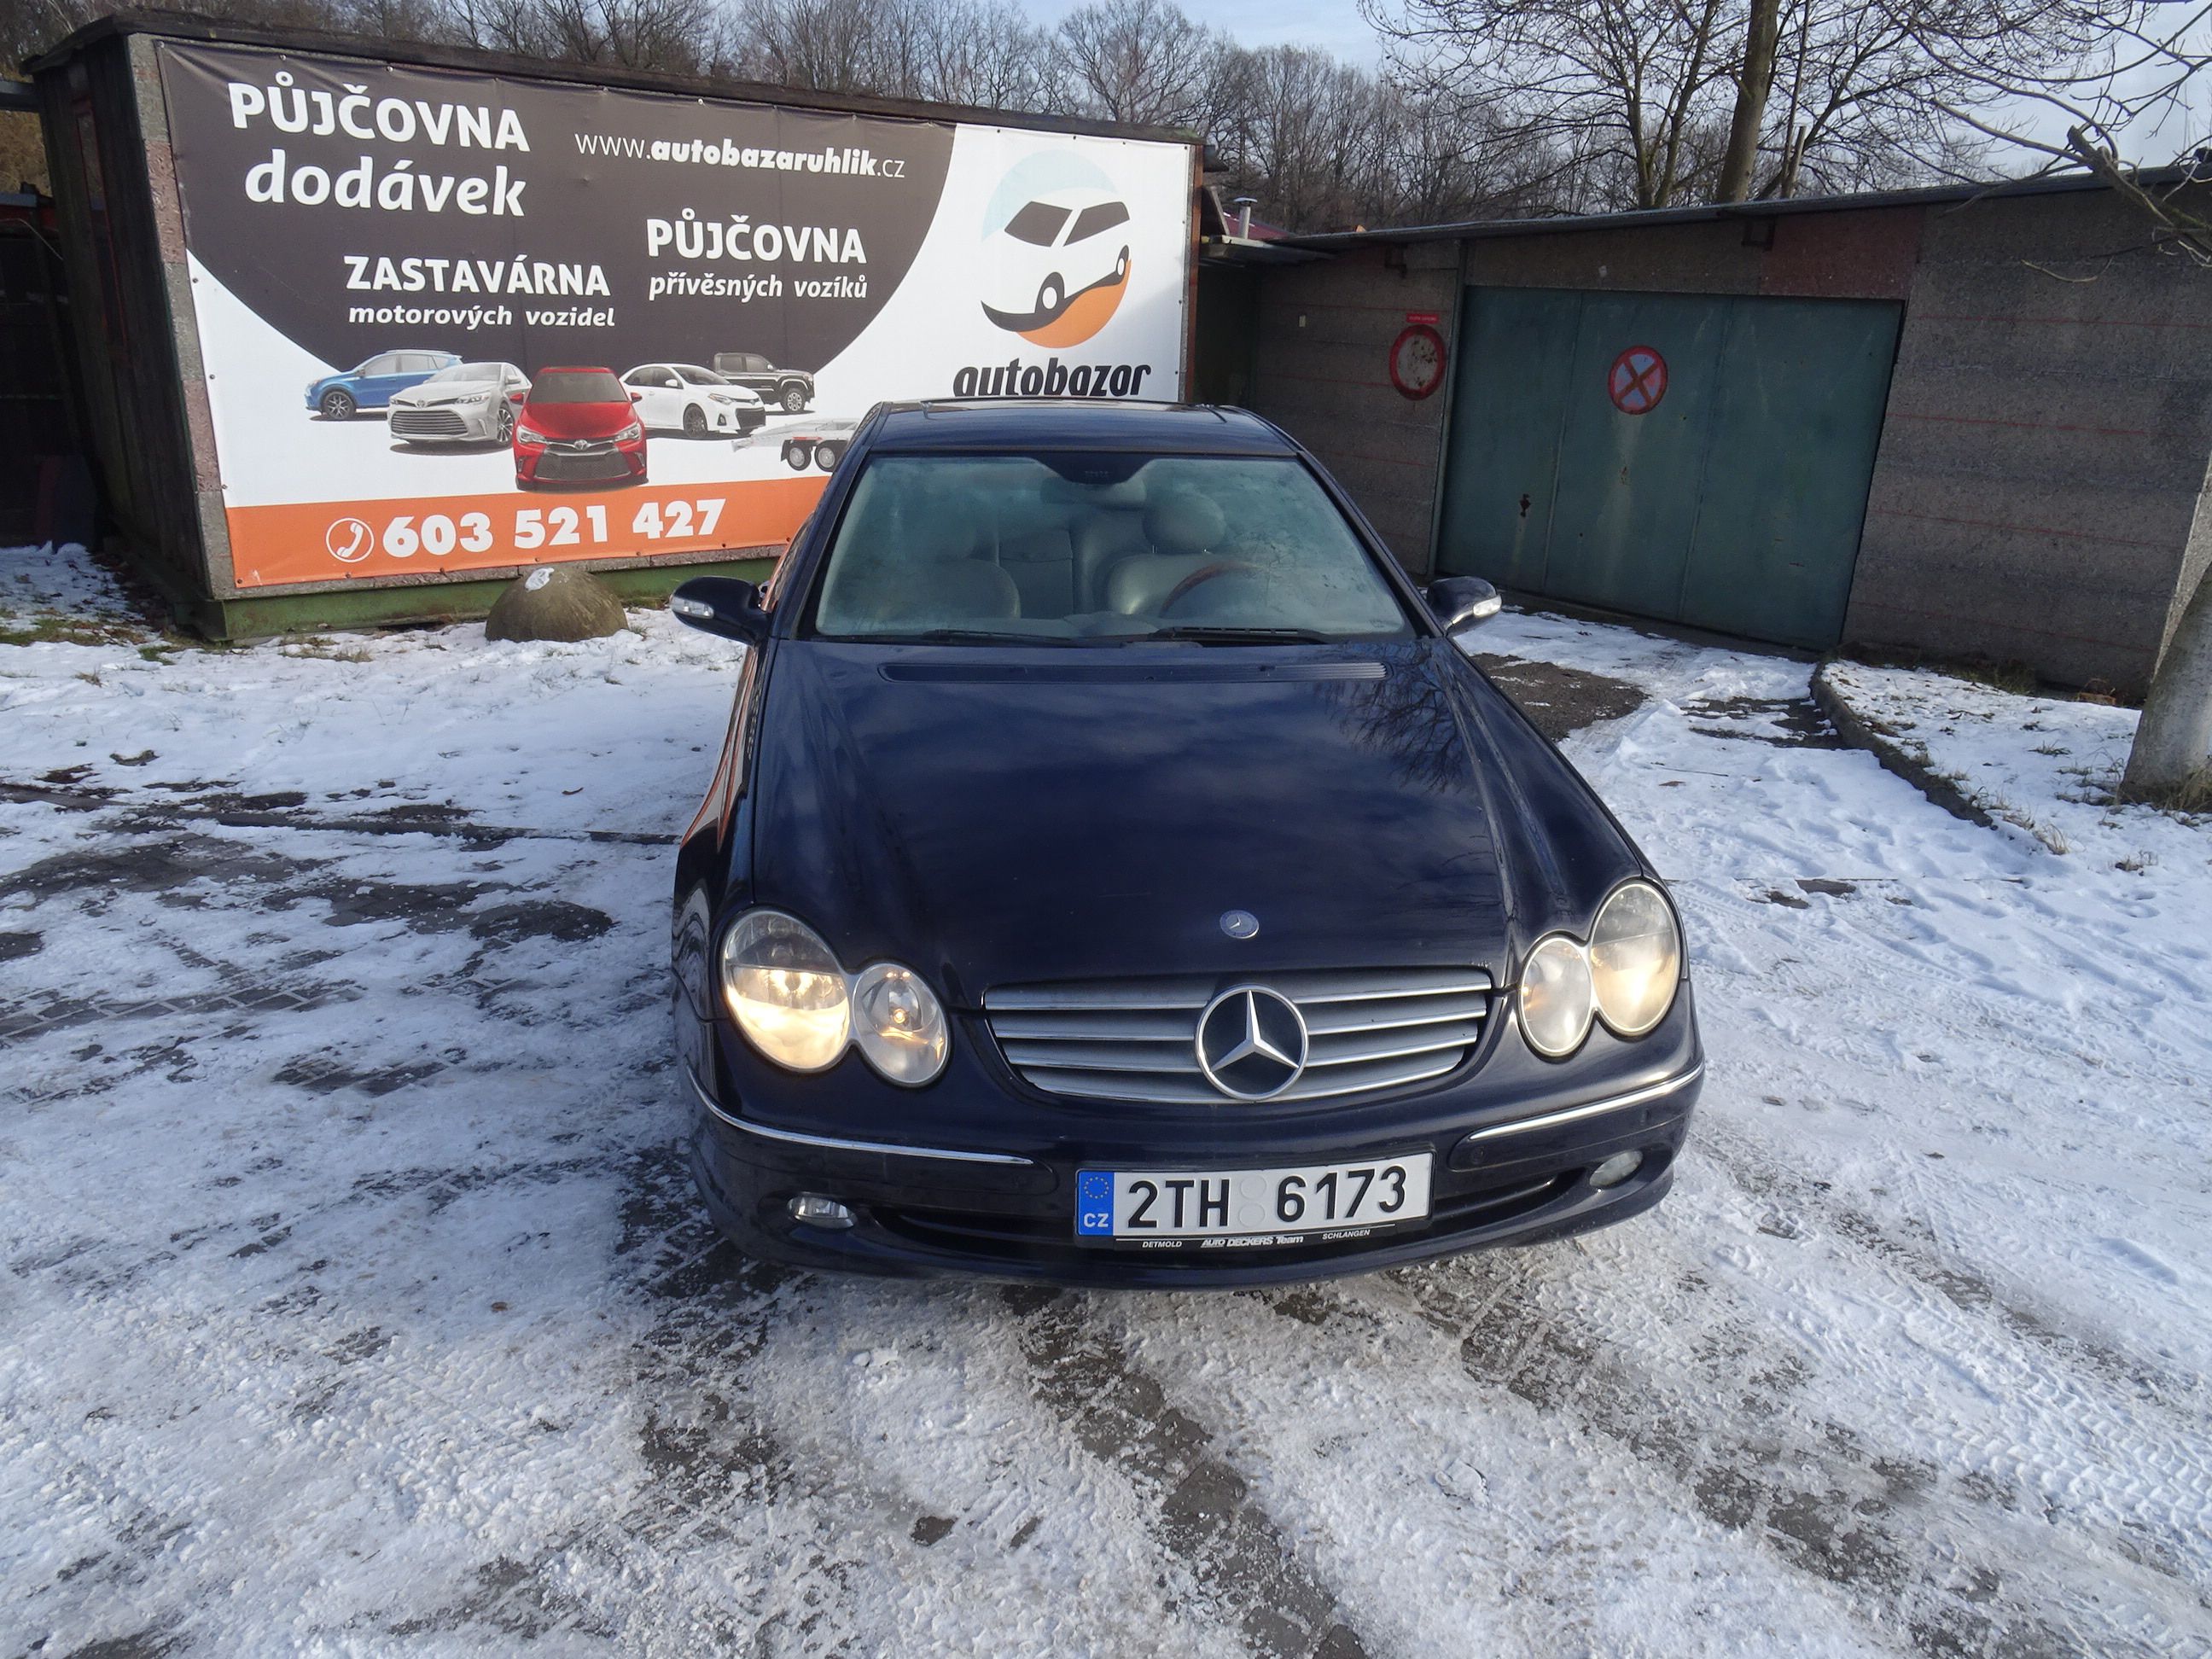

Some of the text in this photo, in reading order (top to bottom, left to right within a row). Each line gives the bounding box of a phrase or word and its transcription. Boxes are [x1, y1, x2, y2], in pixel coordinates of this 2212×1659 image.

[228, 71, 531, 152] PŮJČOVNA
[573, 132, 905, 178] www.autobazaruhlik.cz
[245, 148, 527, 217] dodávek
[646, 207, 868, 264] PŮJČOVNA
[343, 254, 611, 296] ZASTAVÁRNA
[649, 271, 868, 303] přívěsných vozíků
[348, 305, 615, 331] motorových vozidel
[952, 357, 1151, 398] autobazar
[381, 498, 727, 558] 603 521 427
[1127, 1165, 1407, 1229] 2TH 6173
[1083, 1213, 1109, 1229] CZ
[1200, 1238, 1226, 1249] AUTO
[1226, 1235, 1274, 1247] DECKERS
[1322, 1229, 1371, 1241] SCHLANGEN
